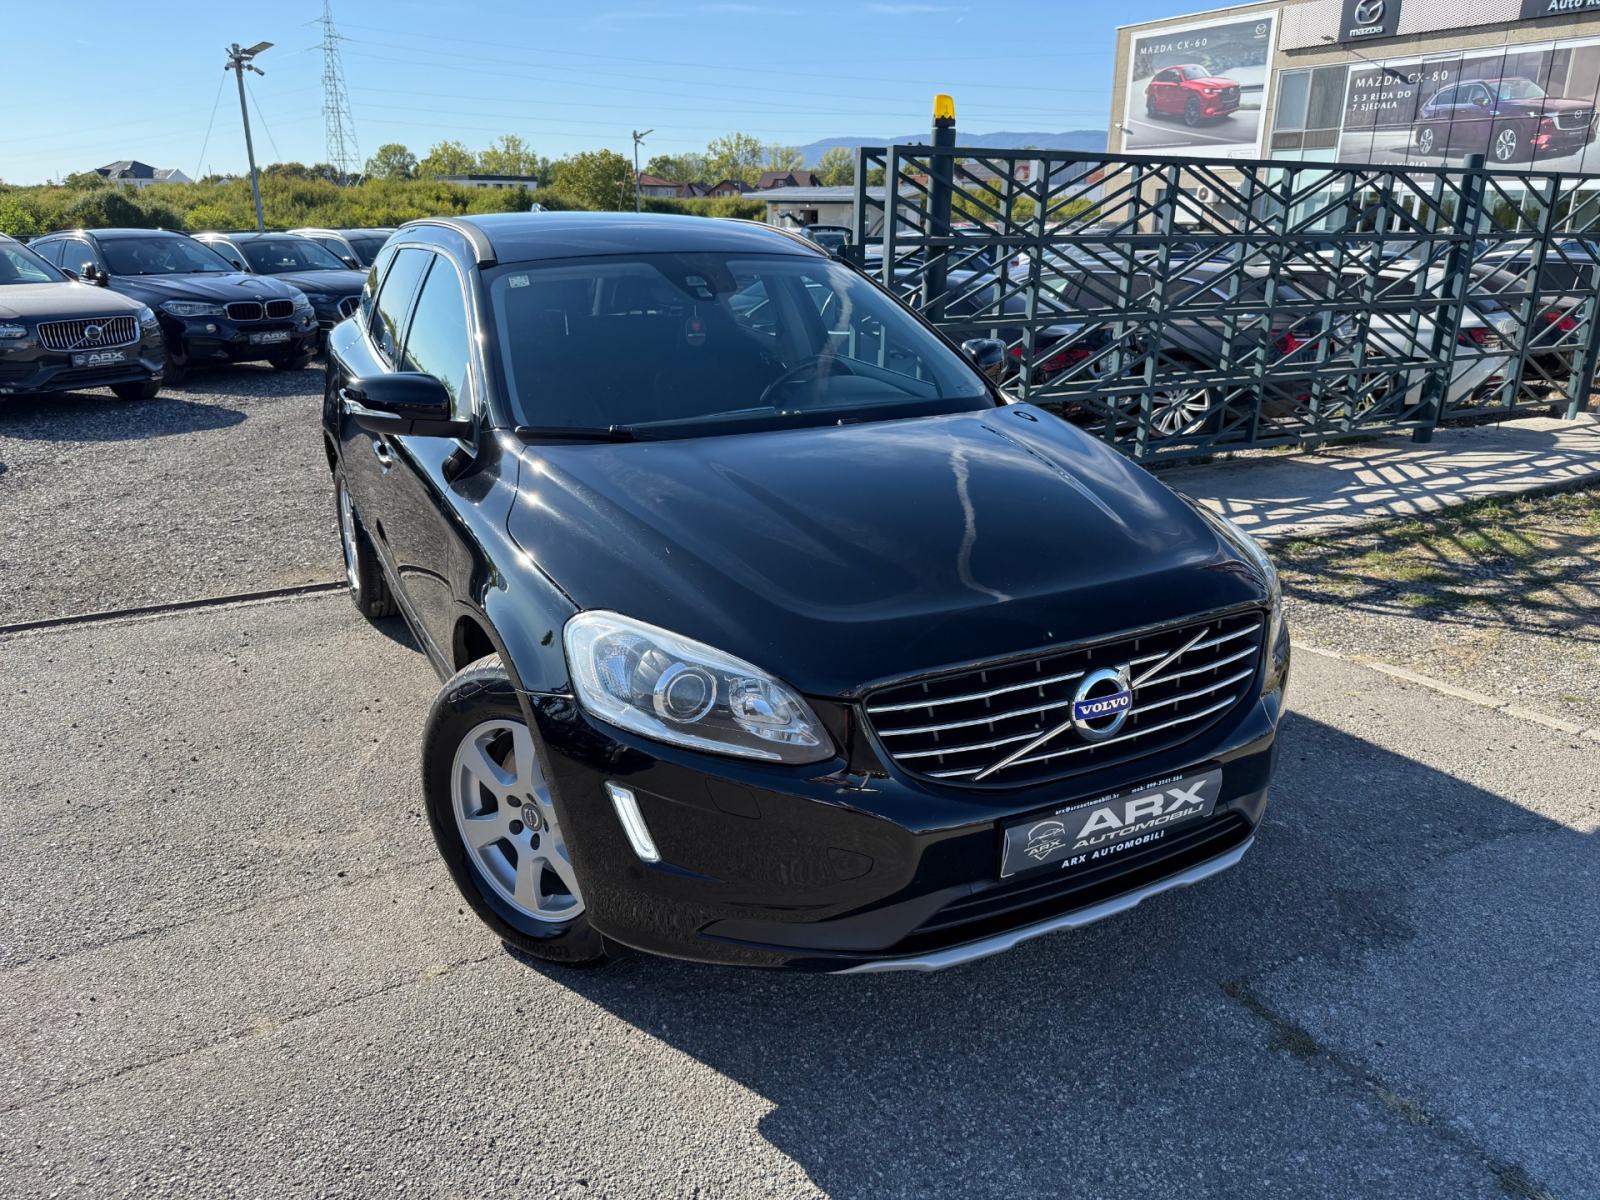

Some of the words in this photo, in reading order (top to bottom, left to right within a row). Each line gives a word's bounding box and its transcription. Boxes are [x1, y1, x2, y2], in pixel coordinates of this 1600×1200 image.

[1547, 0, 1583, 10] Auto
[1350, 26, 1383, 37] mazda
[1140, 44, 1173, 55] MAZDA
[1177, 38, 1207, 50] CX-60
[1355, 75, 1401, 88] MAZDA
[1407, 70, 1448, 83] CX-80
[1397, 90, 1411, 98] DO
[1352, 104, 1357, 112] 7
[89, 352, 124, 361] ARX
[1079, 696, 1129, 715] VOLVO
[1076, 780, 1207, 839] ARX
[1072, 804, 1204, 849] AUTOMOBILI
[1028, 839, 1061, 856] ARX
[1061, 855, 1087, 868] ARX
[1092, 830, 1165, 859] AUTOMOBILI
